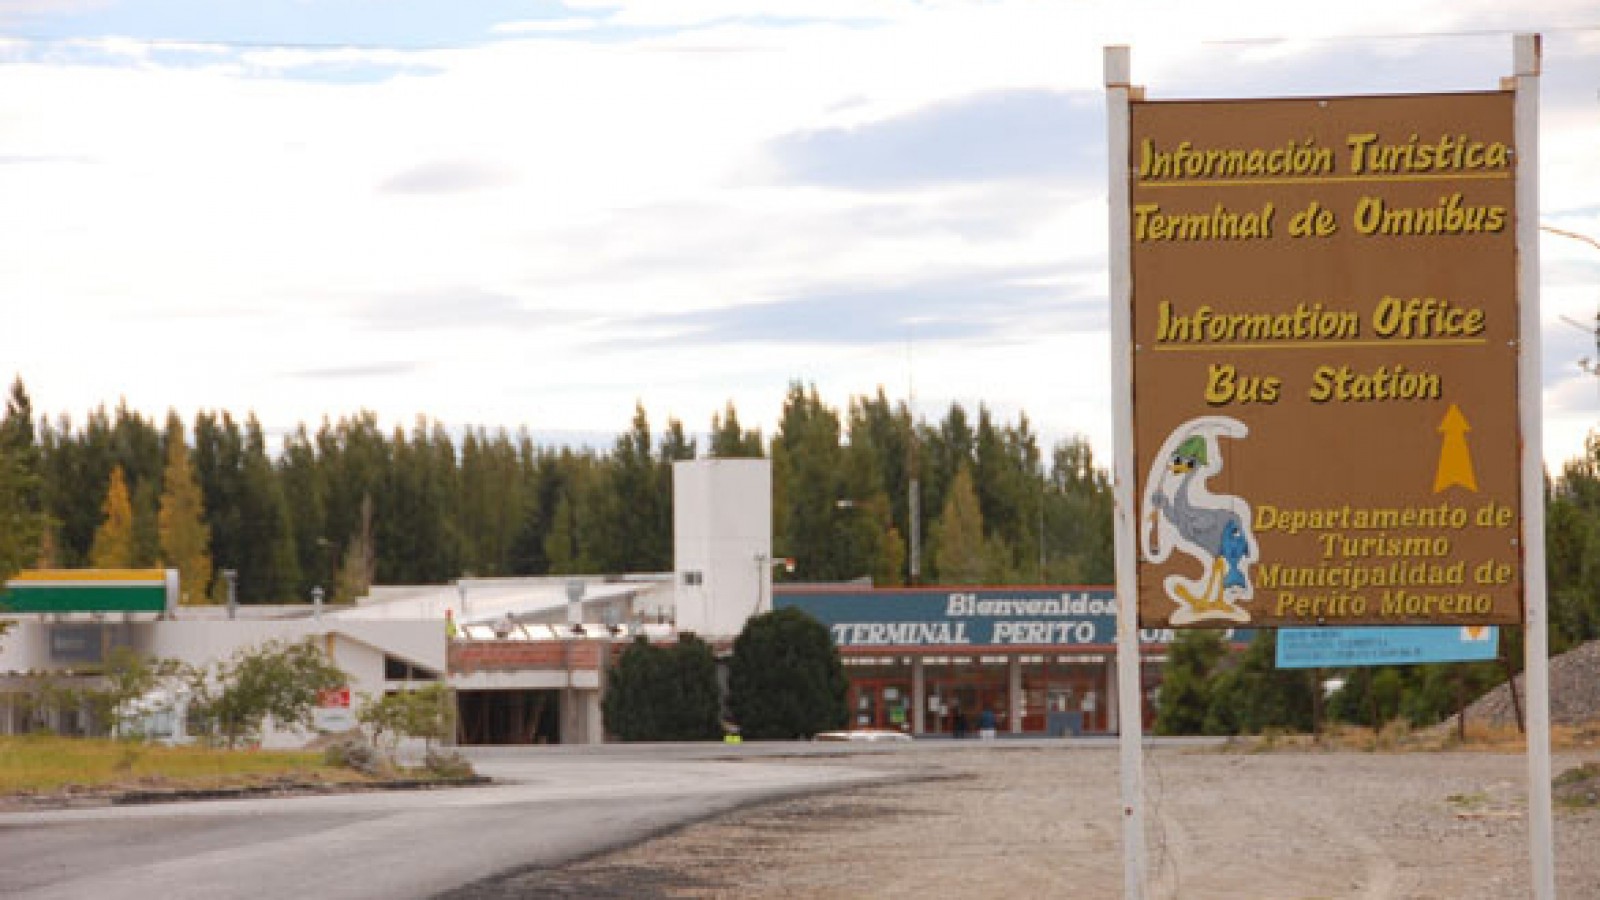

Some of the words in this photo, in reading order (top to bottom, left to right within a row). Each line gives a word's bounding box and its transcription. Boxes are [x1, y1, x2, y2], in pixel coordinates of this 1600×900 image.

[1139, 137, 1335, 180] Información
[1135, 202, 1275, 241] Terminal
[1288, 200, 1338, 237] de
[1353, 191, 1508, 236] Omnibus
[1156, 300, 1360, 343] Information
[1372, 296, 1486, 339] Office
[1205, 364, 1282, 406] Bus
[1309, 364, 1442, 403] Station
[1254, 507, 1467, 534] Departamento
[1475, 504, 1513, 529] de
[1318, 533, 1449, 560] Turismo
[1255, 562, 1465, 591] Municipalidad
[1474, 558, 1513, 586] de
[1276, 591, 1367, 617] Perito
[1380, 590, 1493, 618] Moreno
[831, 622, 970, 645] TERMINAL
[990, 620, 1096, 644] PERITO
